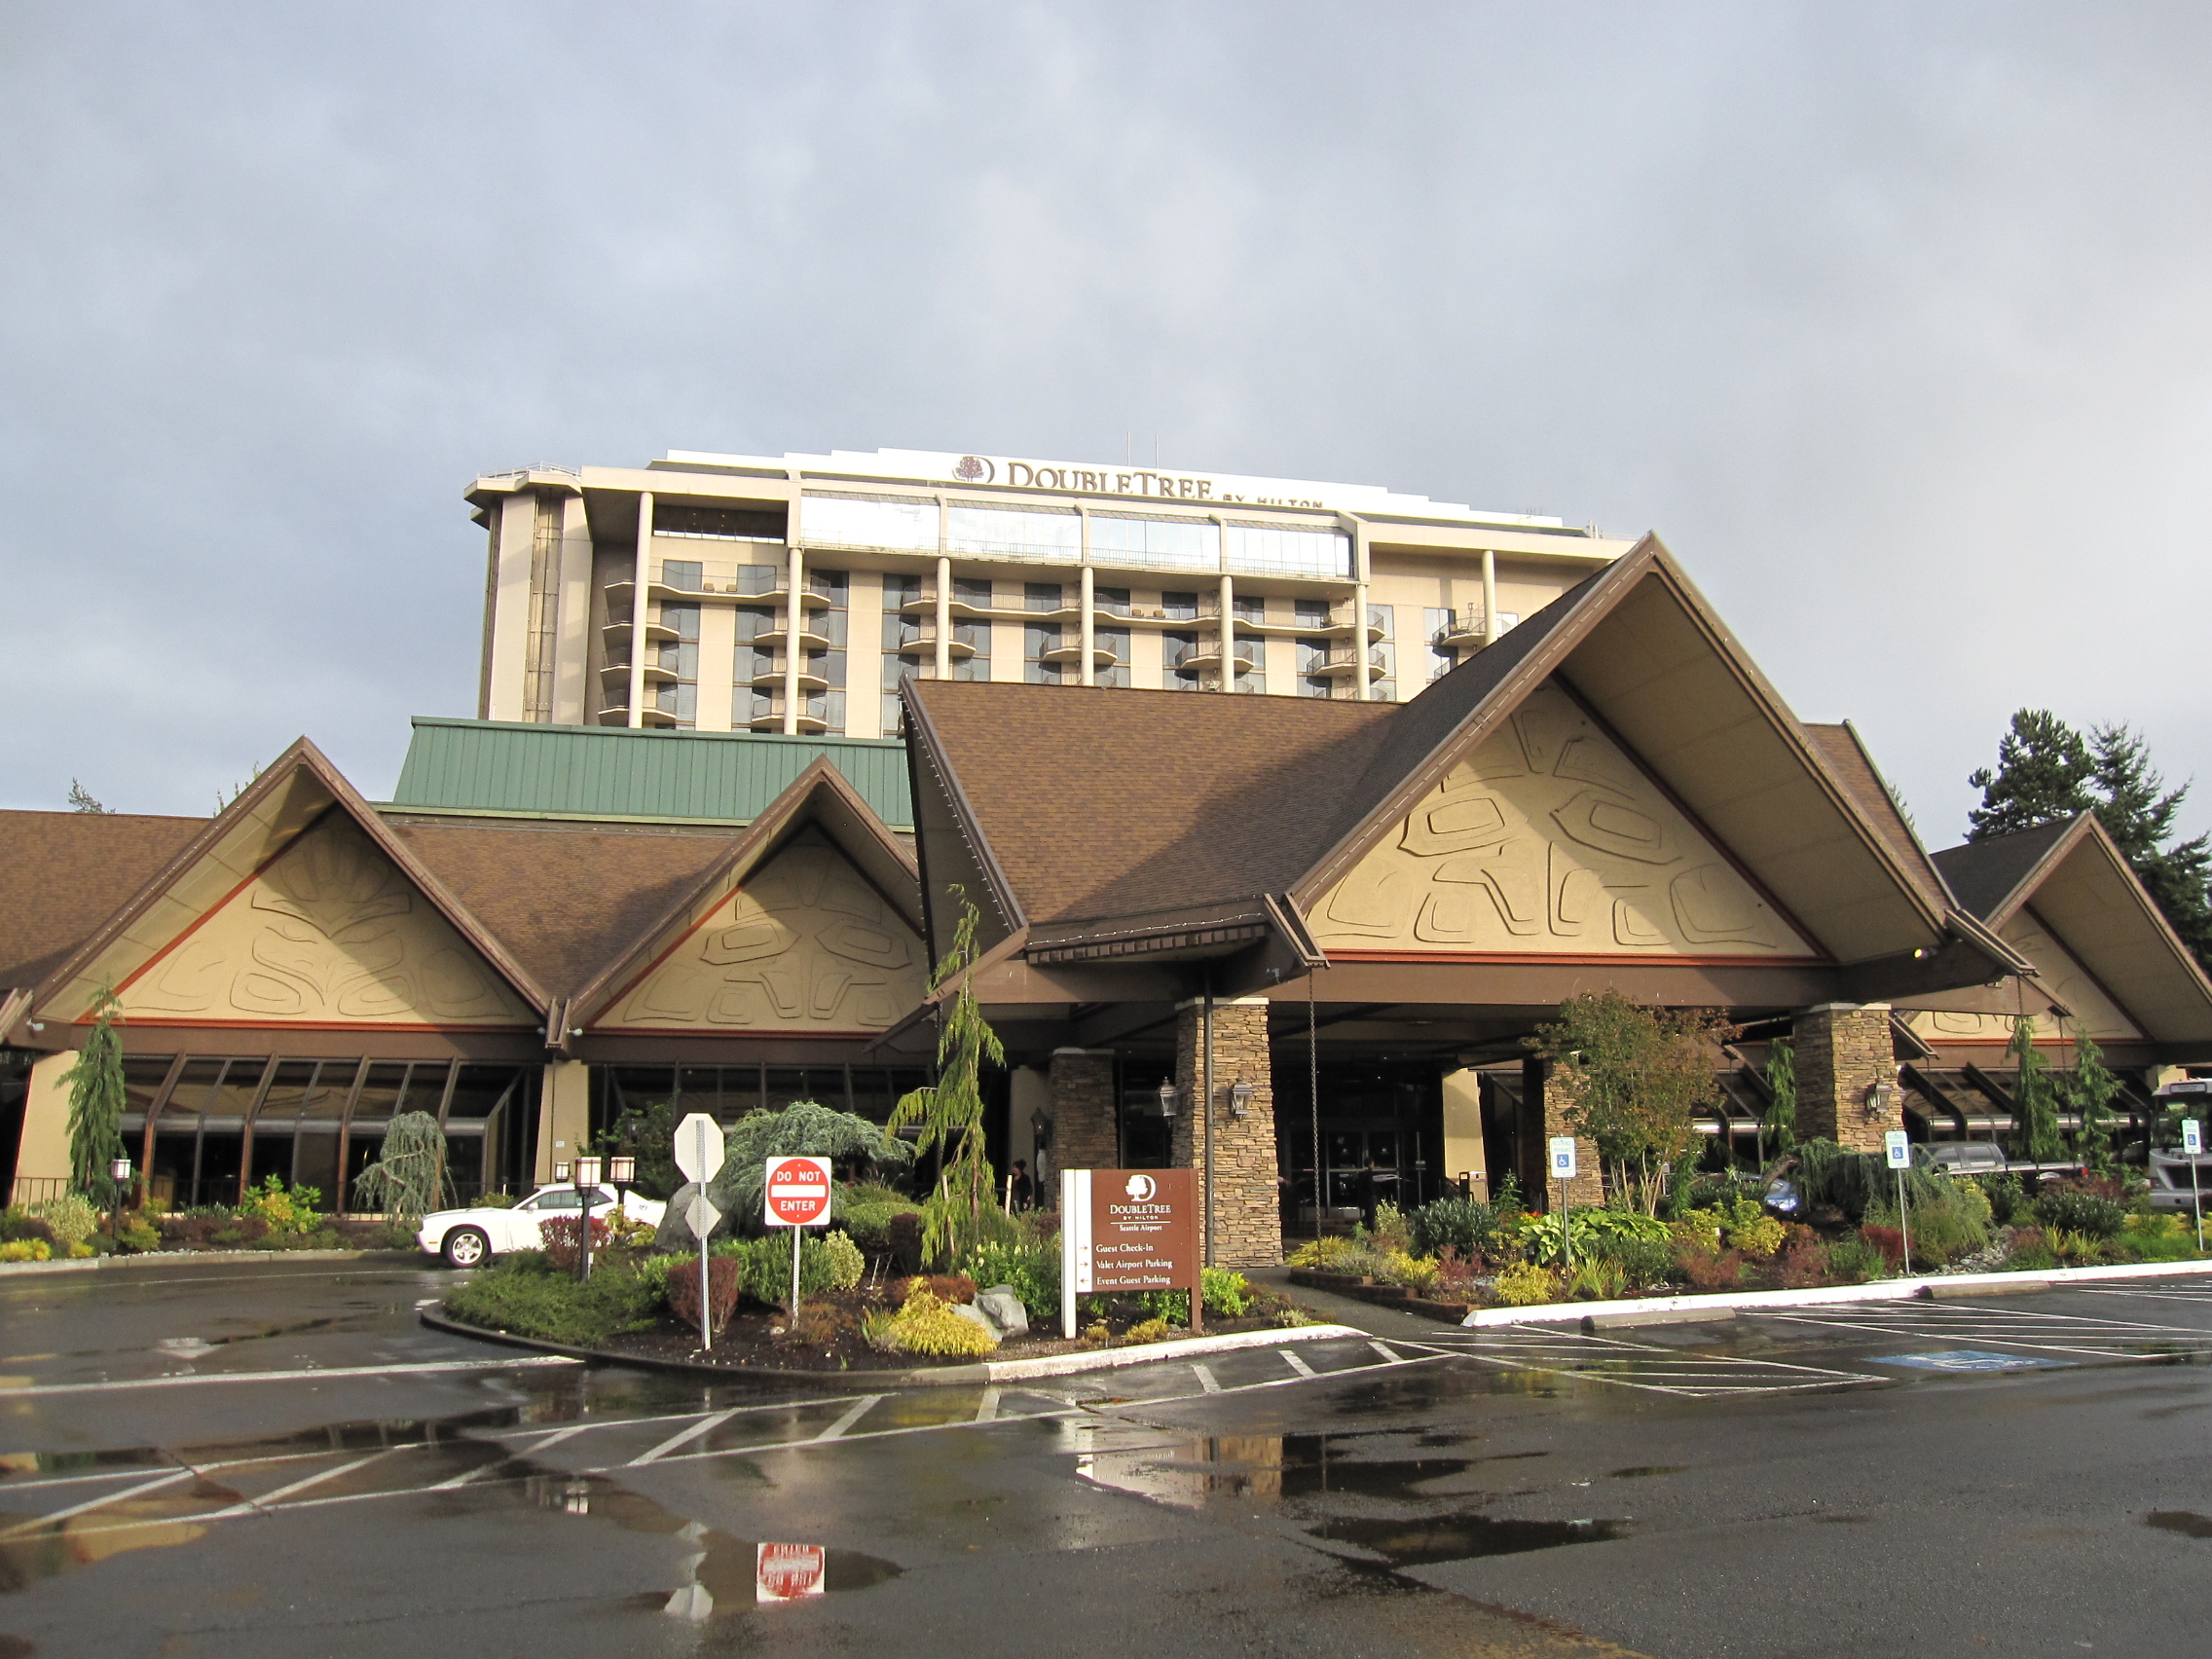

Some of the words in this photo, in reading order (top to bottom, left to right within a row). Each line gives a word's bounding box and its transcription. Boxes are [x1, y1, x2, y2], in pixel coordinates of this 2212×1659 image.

[1008, 462, 1213, 501] DOUBLETREE
[1223, 494, 1245, 502] BY
[777, 1171, 793, 1182] DO
[798, 1171, 821, 1182] NOT
[780, 1200, 816, 1211] ENTER
[1110, 1203, 1172, 1215] DOUBLETREE
[1140, 1224, 1162, 1233] Airport
[1095, 1244, 1119, 1253] Guest
[1120, 1242, 1154, 1252] Check-In
[1096, 1260, 1115, 1270] Valet
[1116, 1259, 1143, 1271] Airport
[1145, 1258, 1173, 1270] Parking
[1096, 1276, 1118, 1286] Event
[1120, 1275, 1141, 1285] Guest
[1143, 1274, 1171, 1286] Parking
